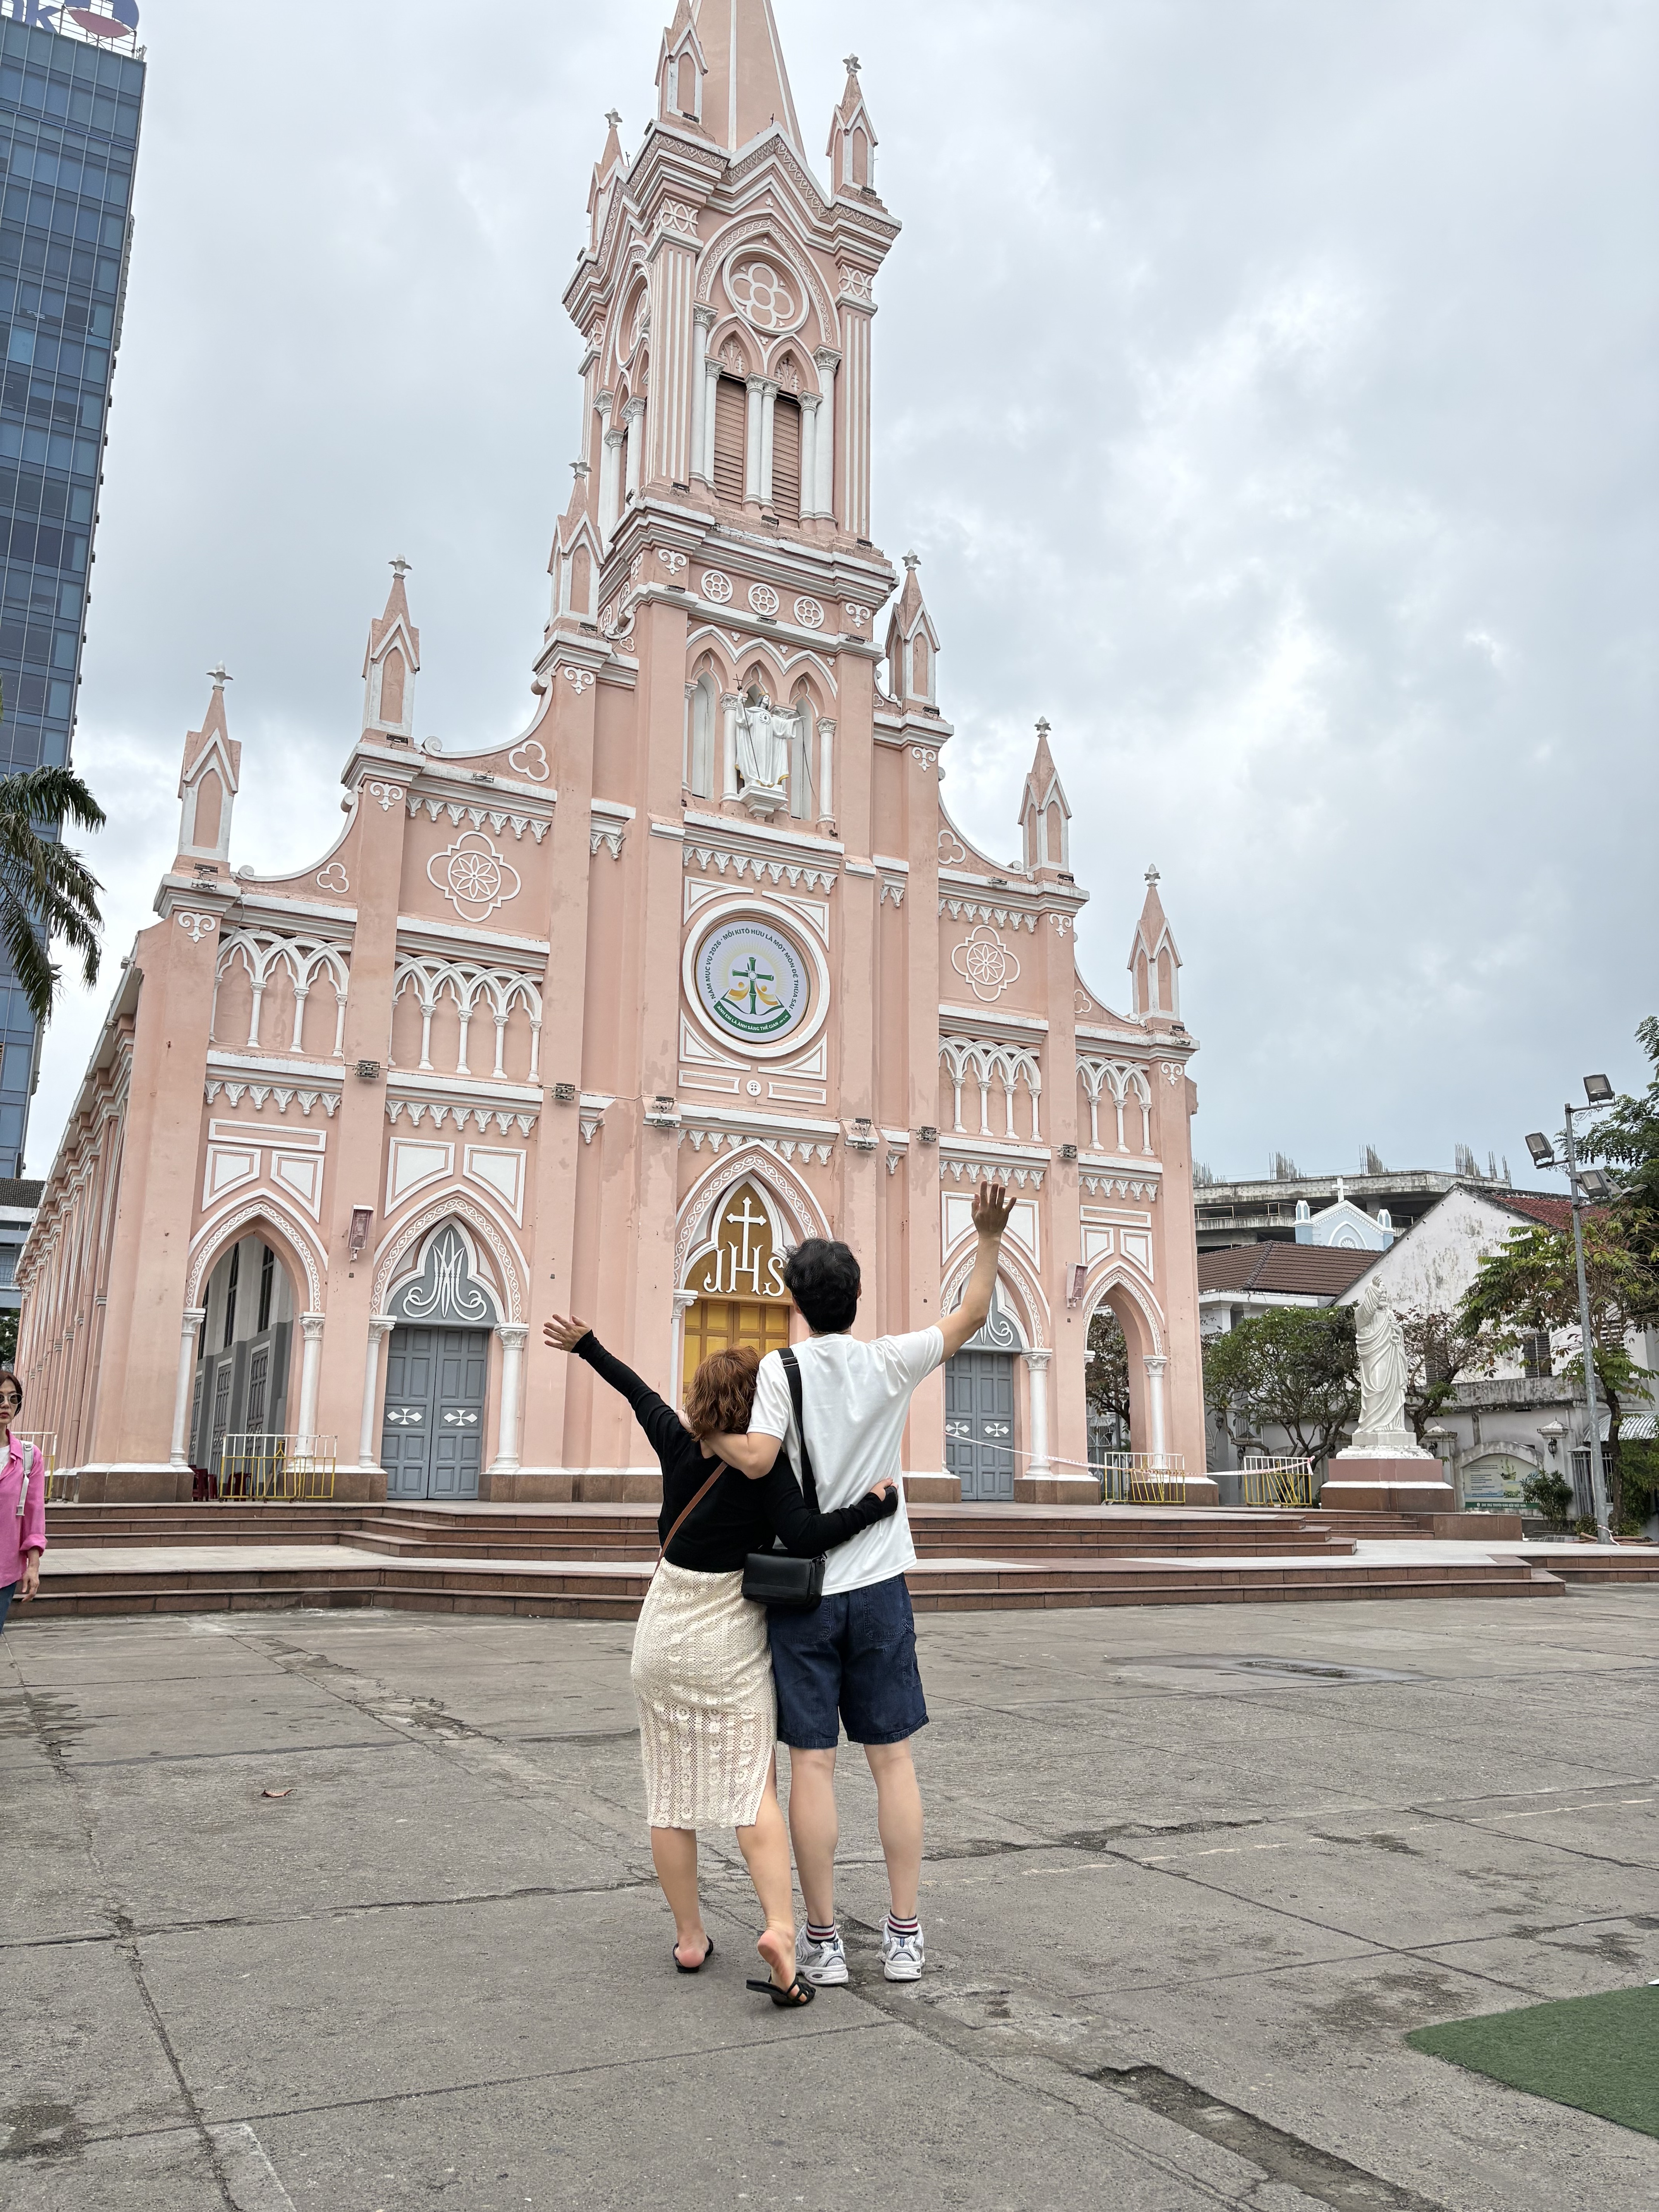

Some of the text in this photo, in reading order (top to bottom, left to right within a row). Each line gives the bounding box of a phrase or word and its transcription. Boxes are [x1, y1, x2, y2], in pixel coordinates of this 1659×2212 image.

[709, 940, 721, 956] 2026
[773, 939, 786, 952] MỘT
[784, 952, 795, 968] MÔN
[717, 1006, 726, 1015] ANH
[788, 998, 797, 1010] SAI
